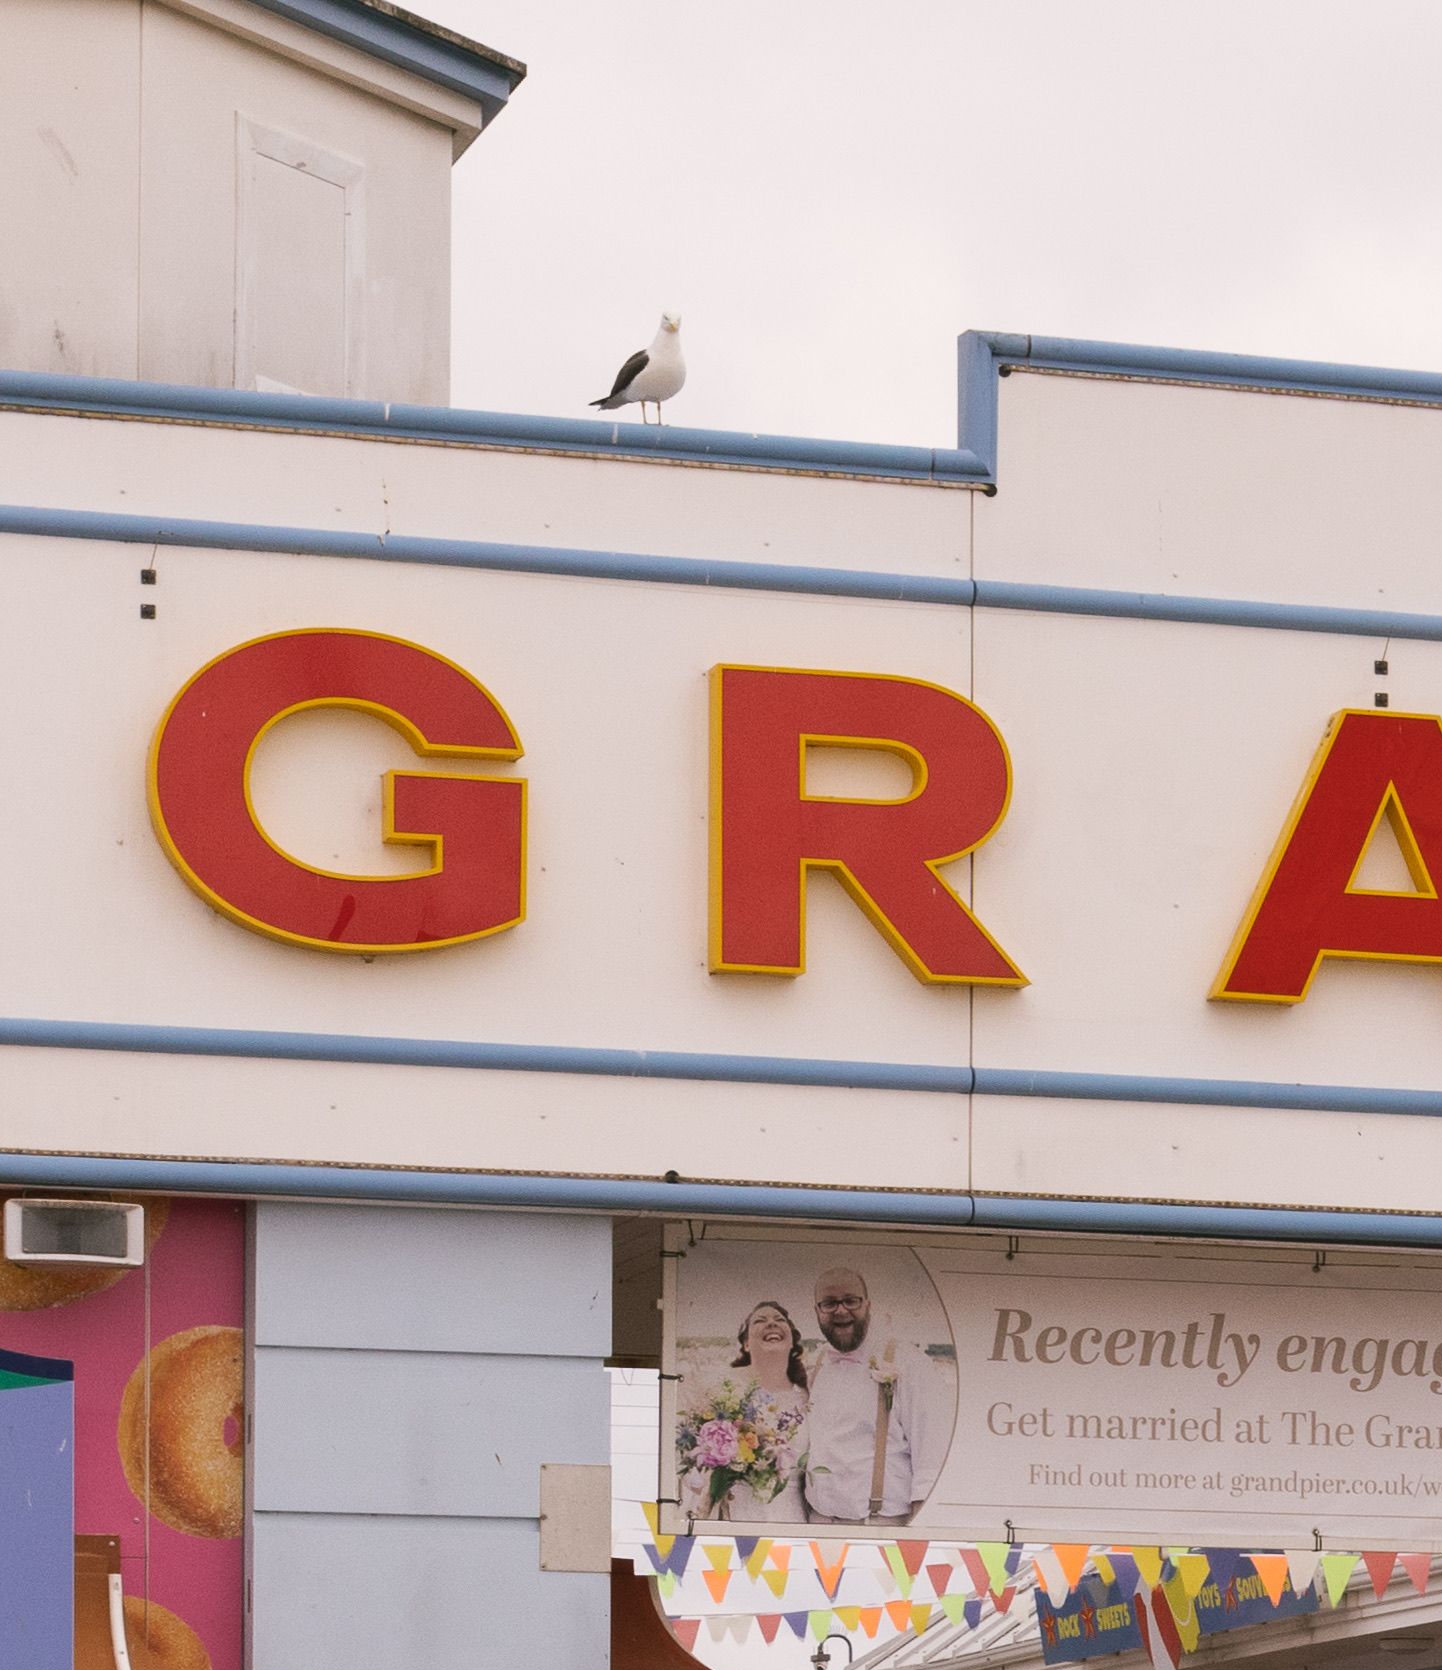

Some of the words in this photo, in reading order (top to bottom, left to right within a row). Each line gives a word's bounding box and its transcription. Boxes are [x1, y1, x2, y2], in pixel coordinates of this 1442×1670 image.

[987, 1307, 1260, 1388] Recently
[986, 1402, 1055, 1439] Get
[1065, 1407, 1224, 1444] married
[1234, 1415, 1271, 1444] at
[1281, 1410, 1355, 1447] The
[1027, 1462, 1082, 1489] Find
[1089, 1467, 1128, 1489] out
[1135, 1471, 1196, 1490] more
[1202, 1470, 1224, 1491] at
